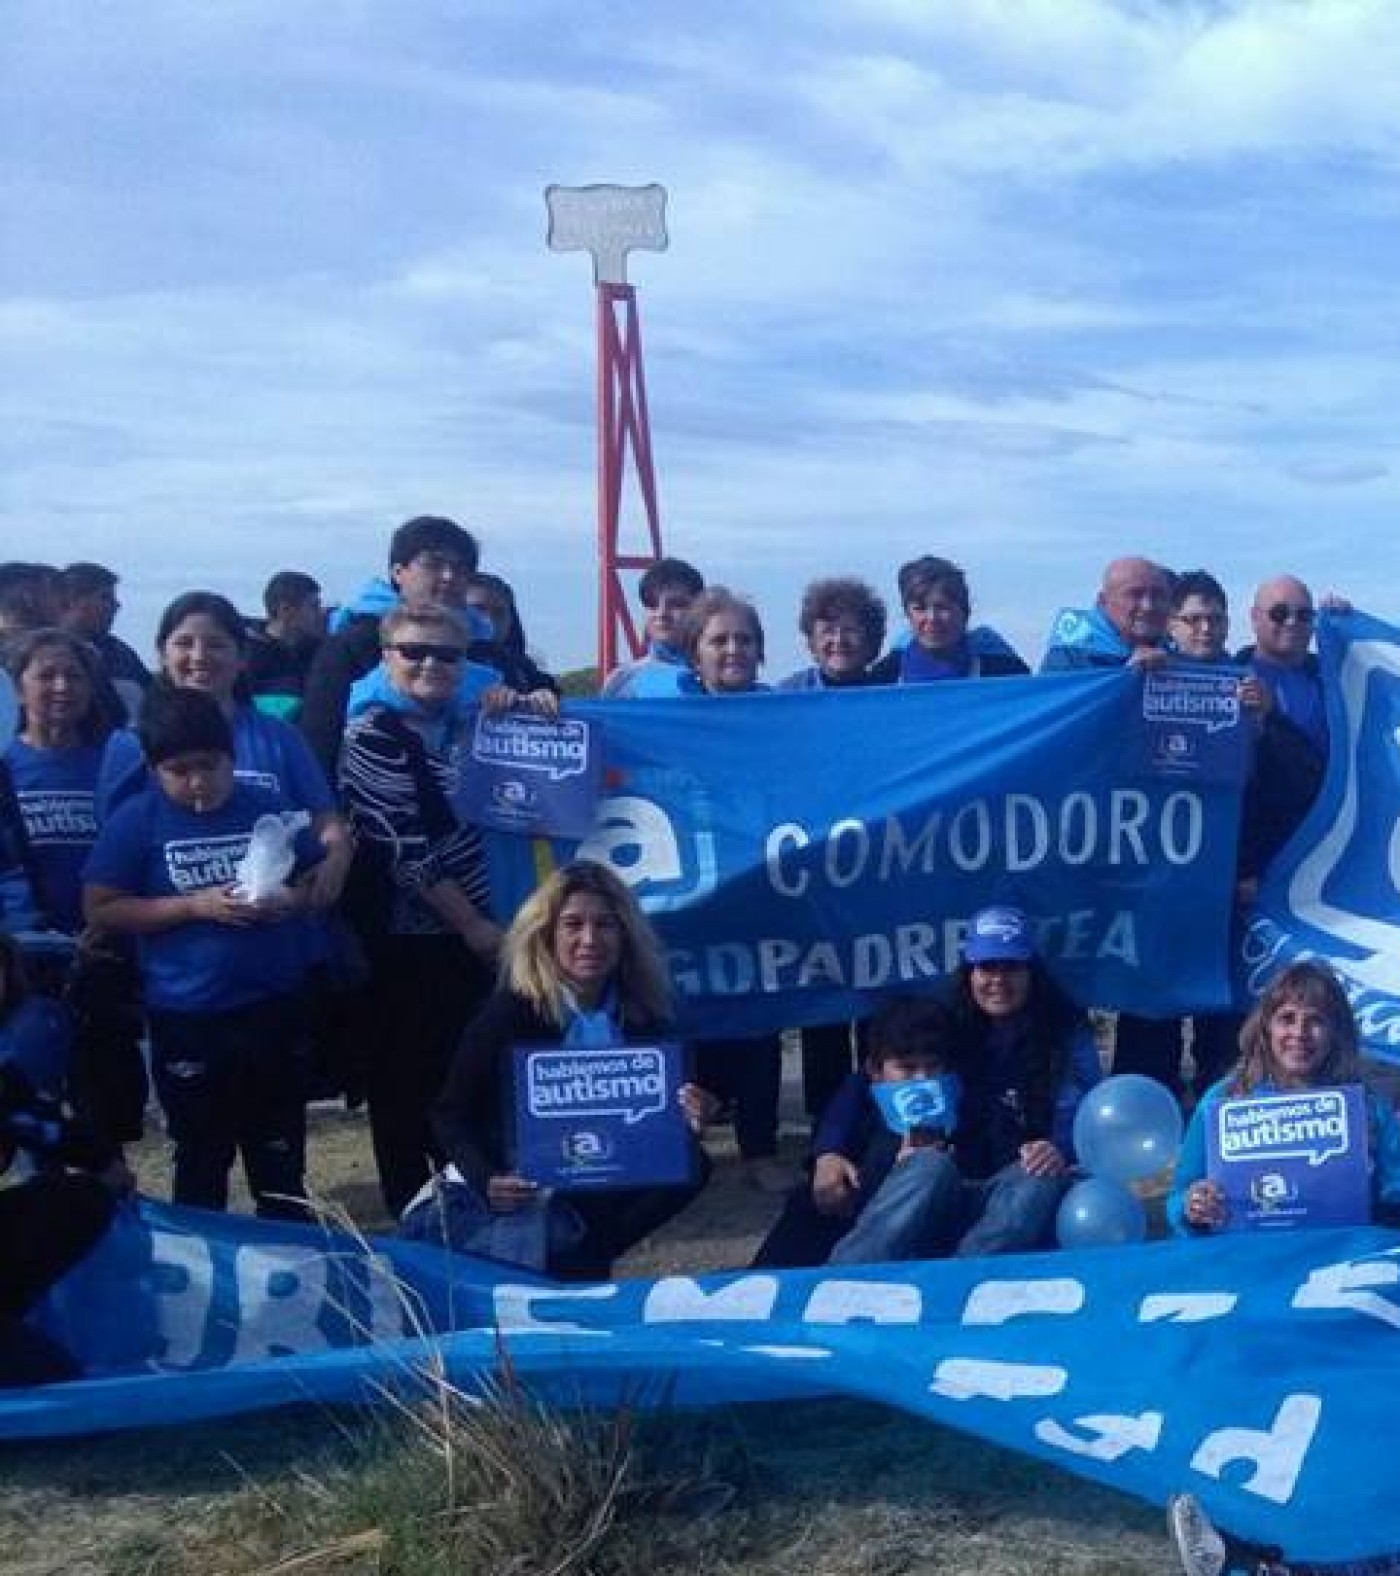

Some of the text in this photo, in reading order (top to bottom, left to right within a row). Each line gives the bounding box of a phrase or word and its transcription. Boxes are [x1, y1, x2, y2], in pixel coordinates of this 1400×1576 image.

[766, 790, 1203, 898] COMODORO
[532, 1073, 660, 1106] autismo
[1223, 1117, 1342, 1149] autismo
